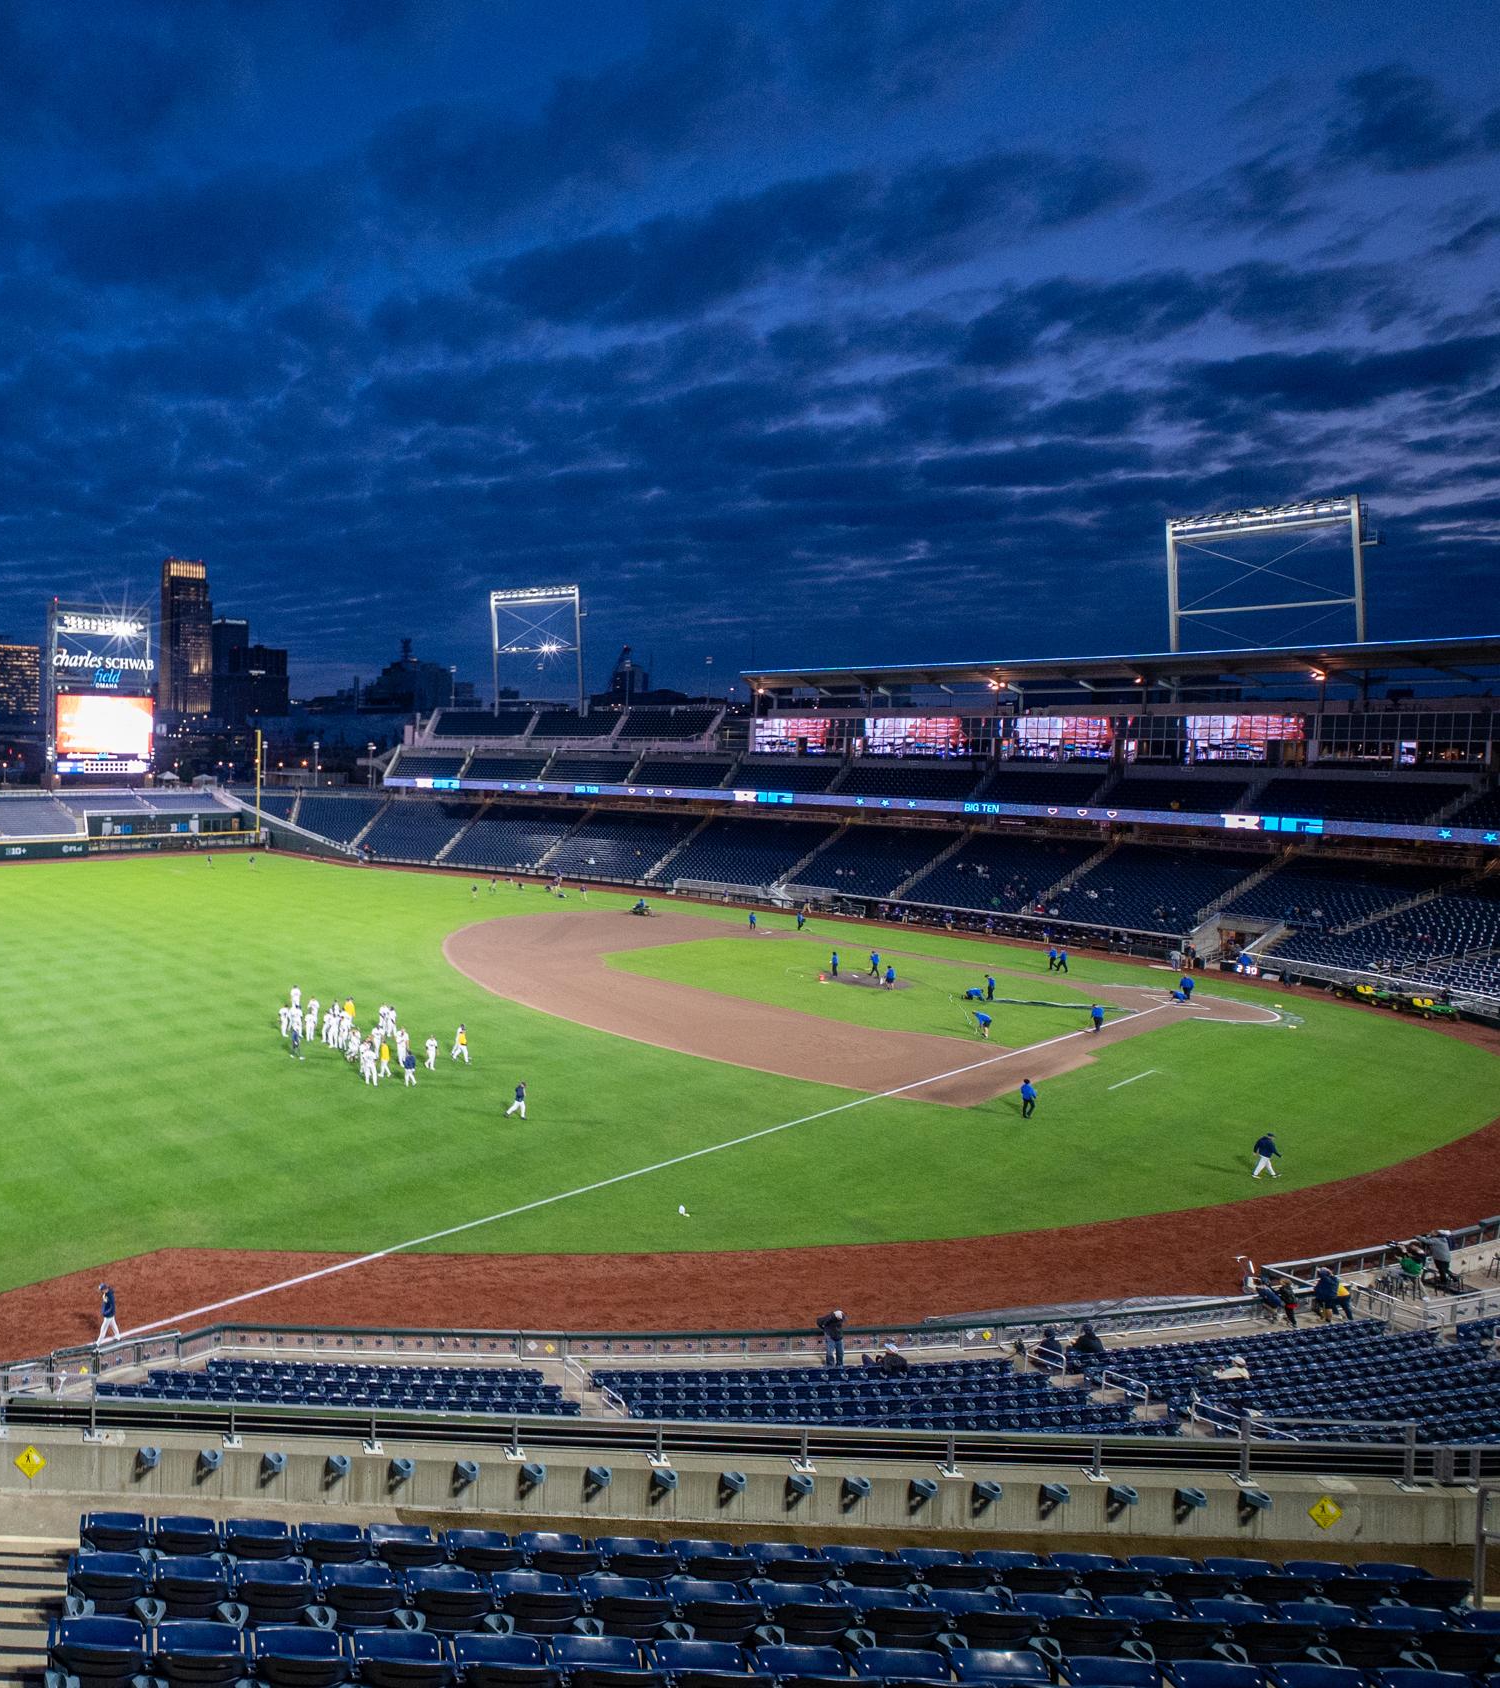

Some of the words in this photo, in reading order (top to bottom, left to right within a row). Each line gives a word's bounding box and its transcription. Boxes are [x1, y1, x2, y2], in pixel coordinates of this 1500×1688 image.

[52, 648, 103, 668] charles
[105, 657, 154, 671] SCHWAB
[94, 668, 122, 686] field
[575, 785, 586, 793] BIG
[587, 786, 599, 794] TEN
[964, 803, 979, 812] BIG
[981, 804, 1000, 813] TEN
